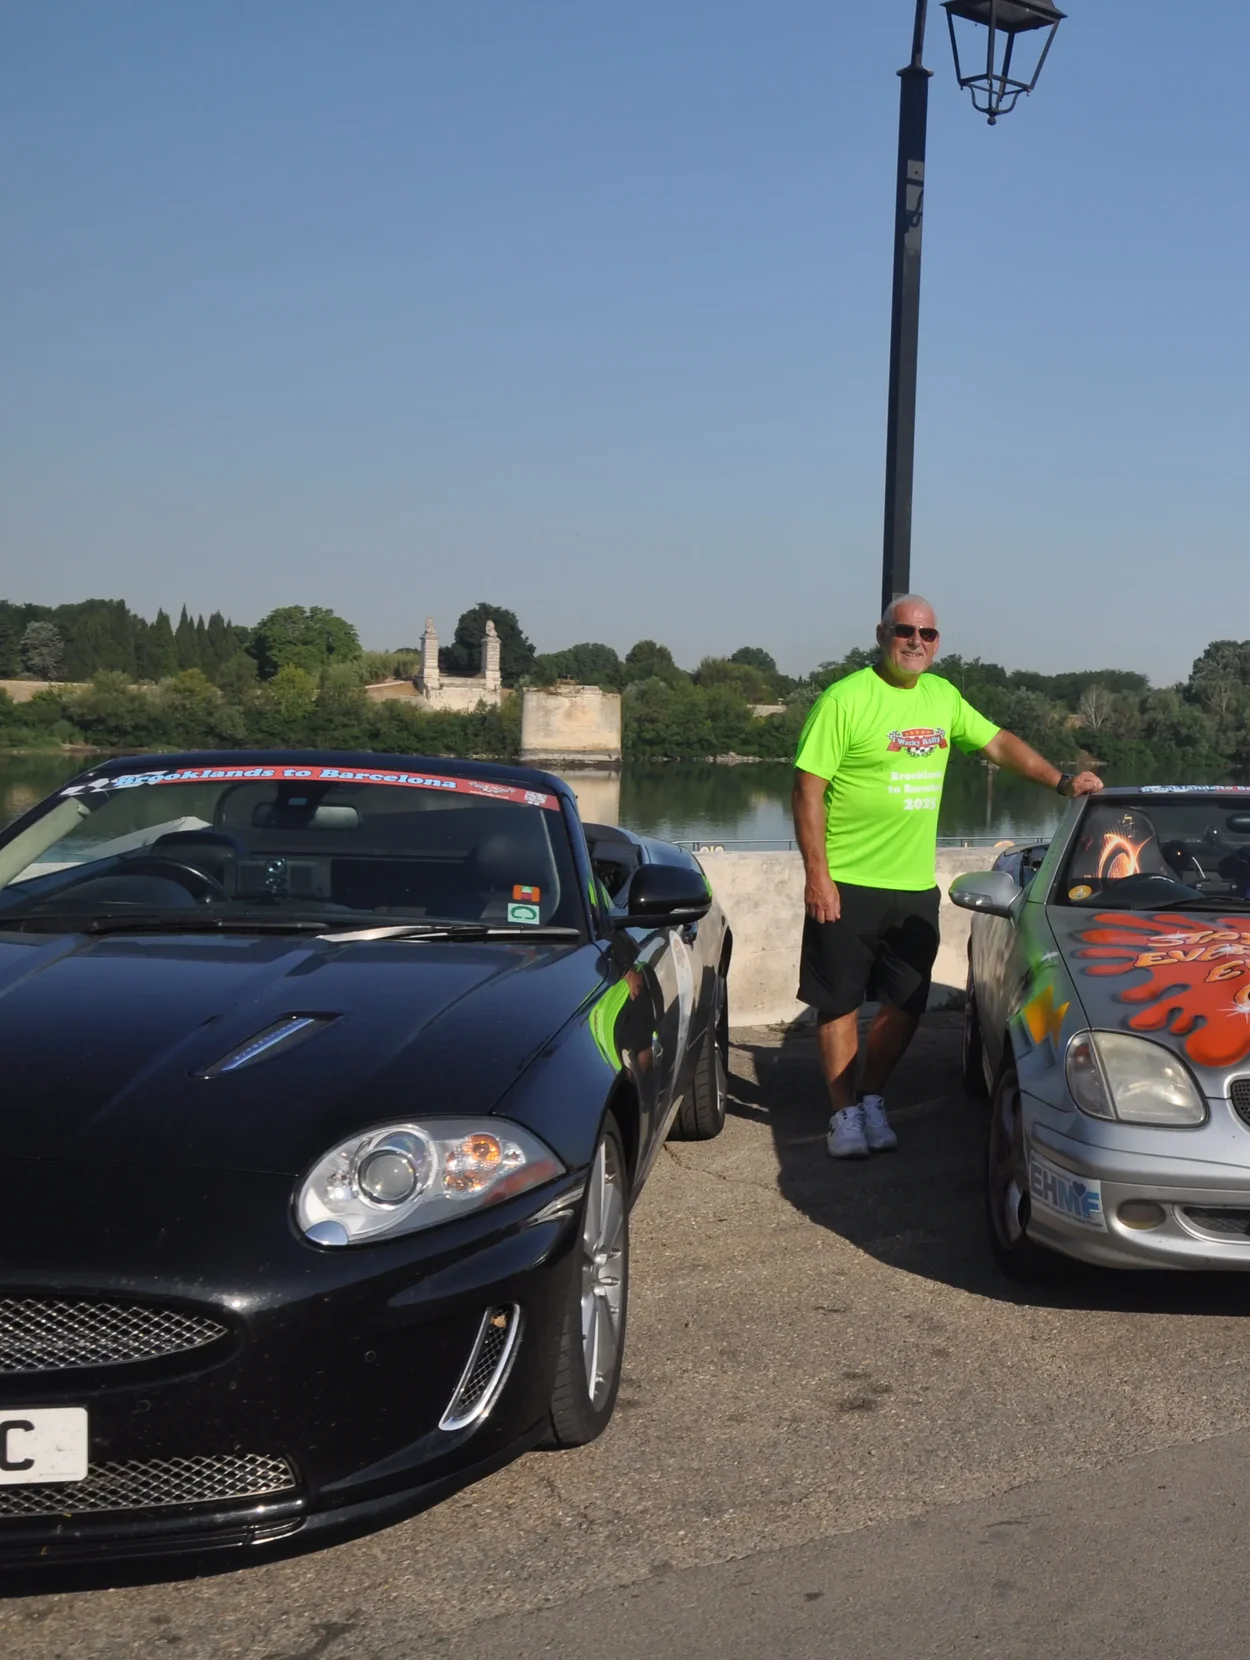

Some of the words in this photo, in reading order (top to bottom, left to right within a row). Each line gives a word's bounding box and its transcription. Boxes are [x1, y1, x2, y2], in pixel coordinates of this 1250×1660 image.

[897, 737, 920, 747] Wacky
[922, 736, 940, 745] Rally
[113, 767, 276, 787] Brooklands
[282, 768, 312, 777] to
[319, 768, 457, 789] Barcelona
[888, 785, 901, 794] to
